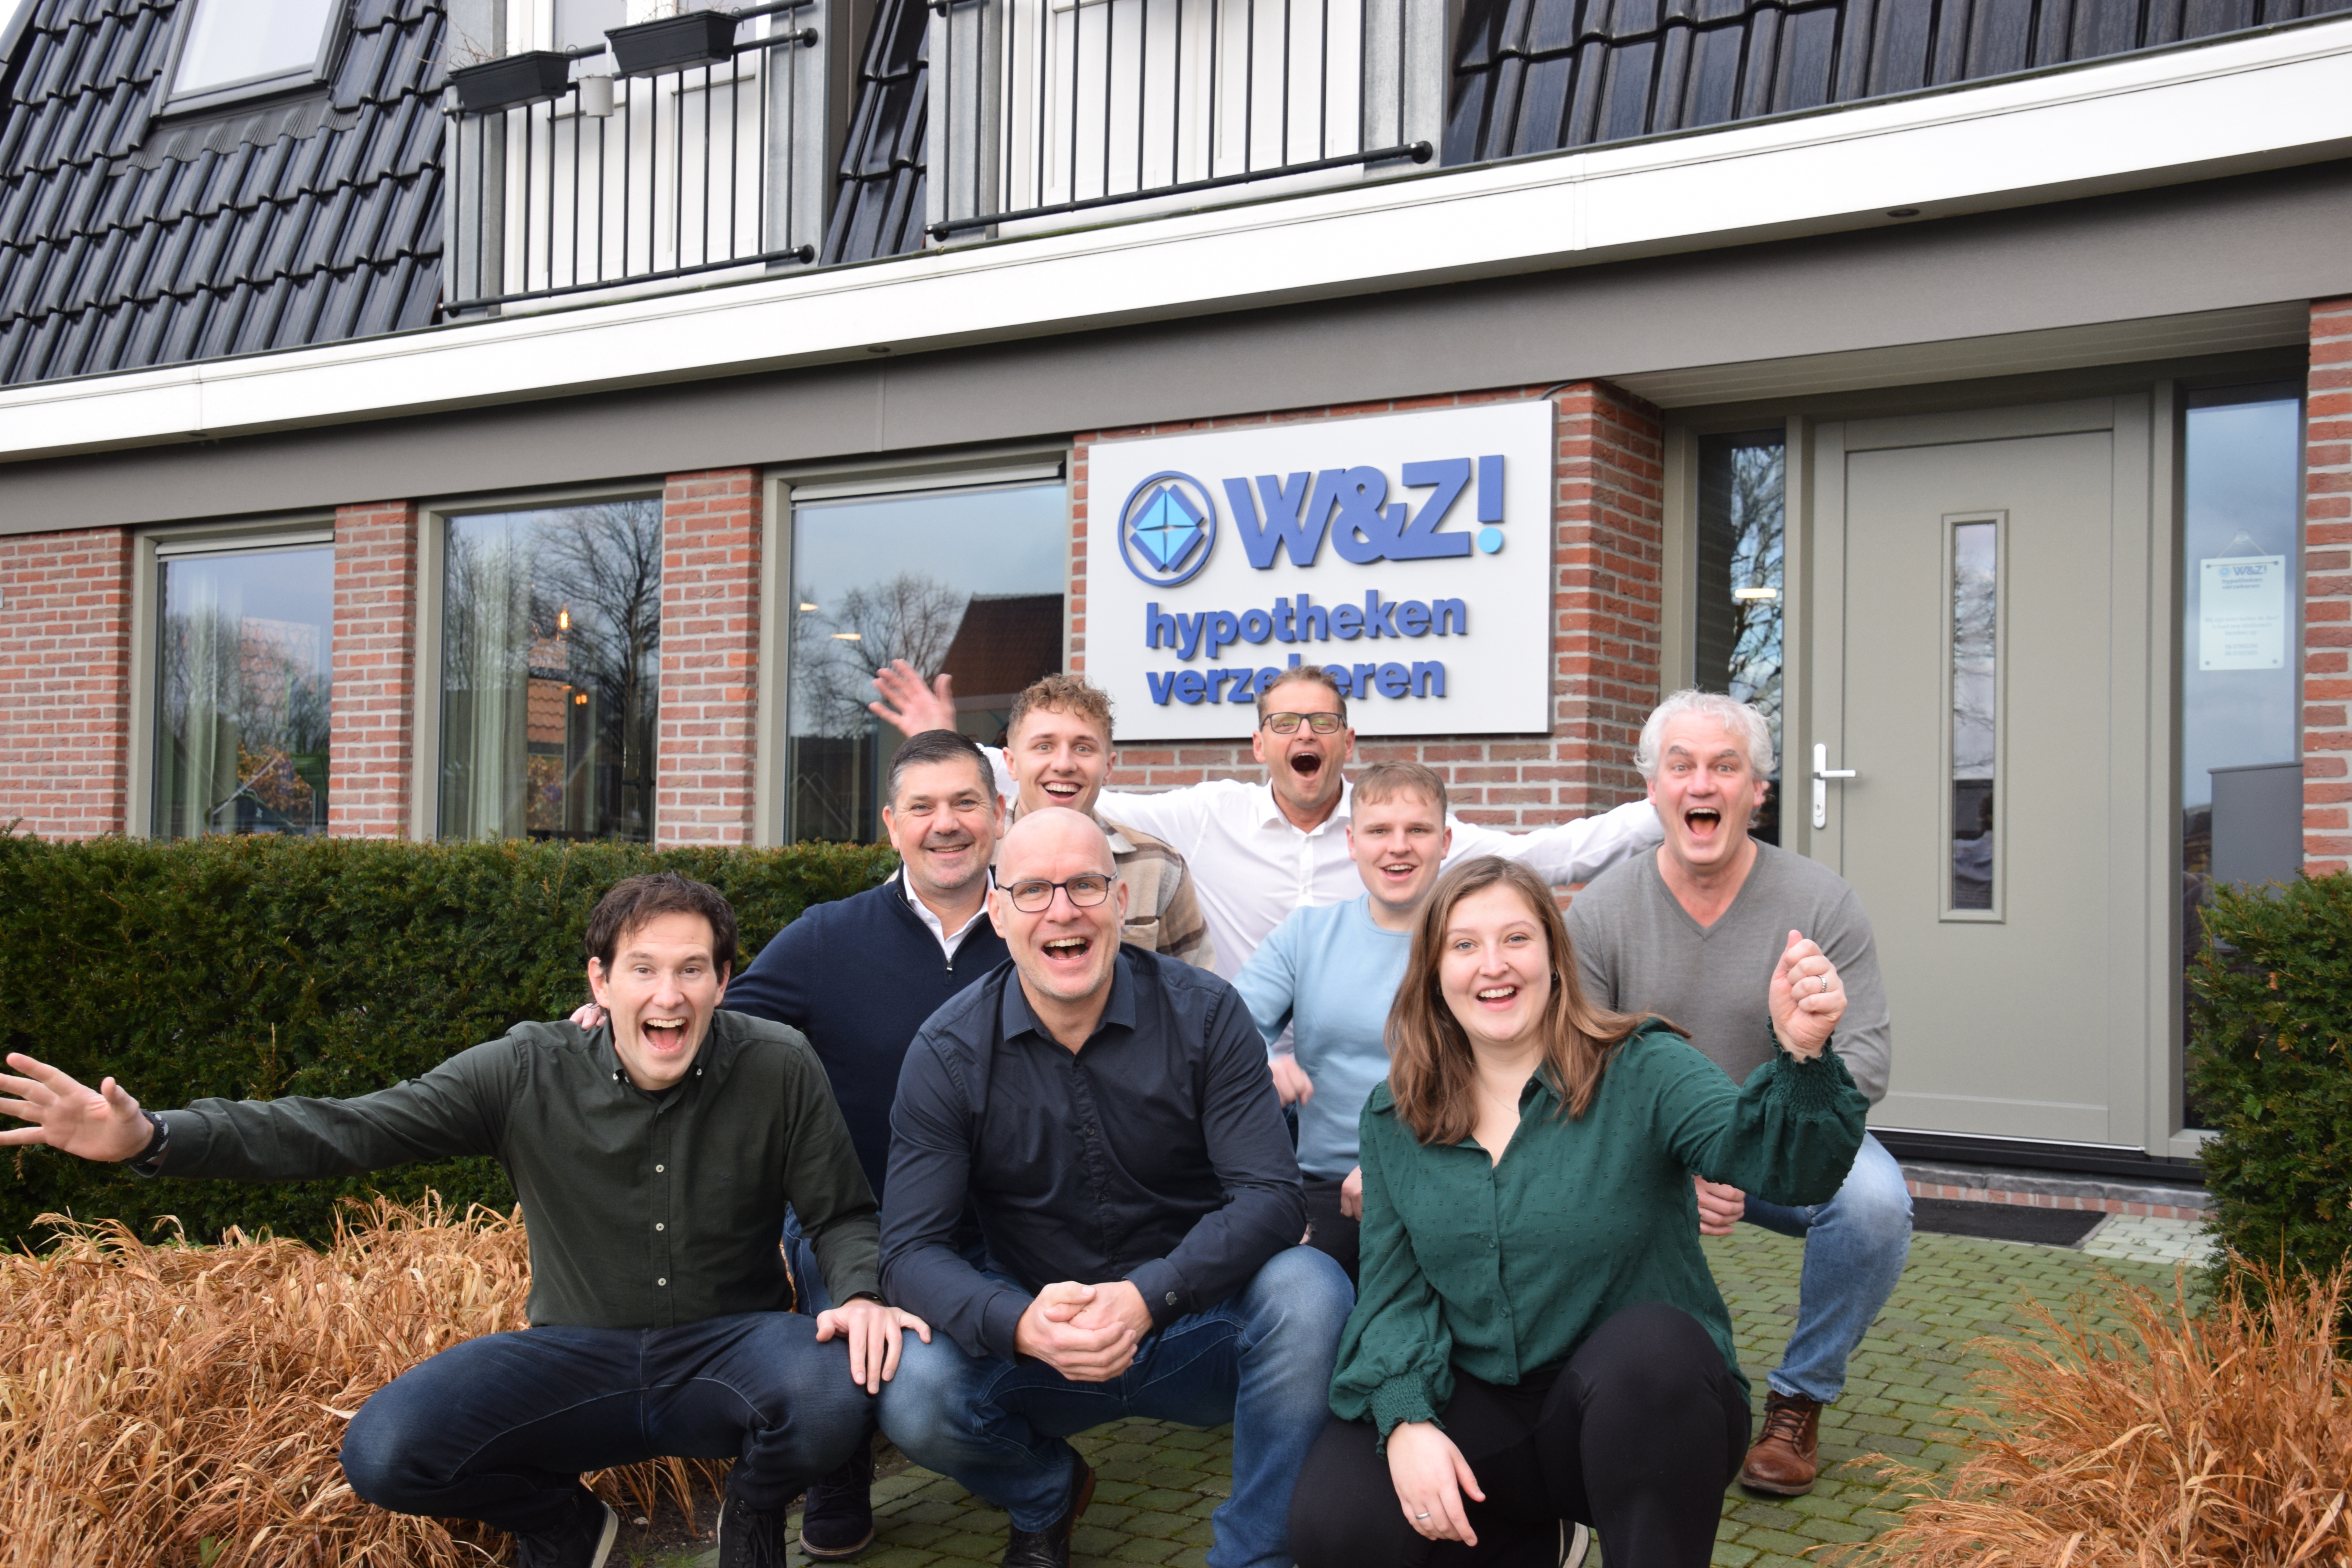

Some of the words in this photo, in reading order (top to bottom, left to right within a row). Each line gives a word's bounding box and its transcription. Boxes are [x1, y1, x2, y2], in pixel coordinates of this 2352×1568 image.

[1222, 454, 1504, 569] W&Z!
[2233, 565, 2267, 575] W&Z!
[1146, 590, 1466, 659] hypotheken
[1146, 653, 1446, 705] verzeeren
